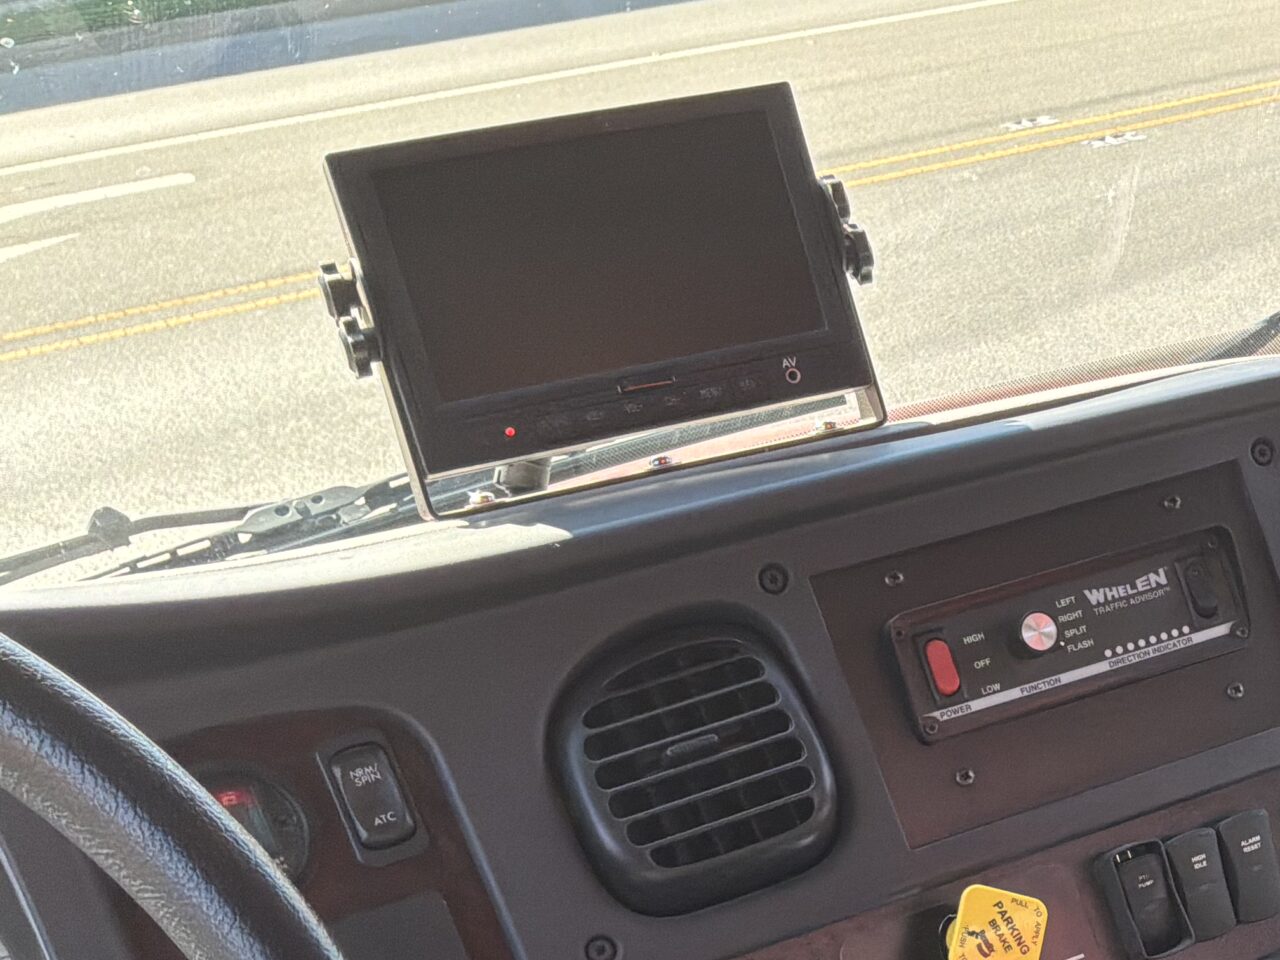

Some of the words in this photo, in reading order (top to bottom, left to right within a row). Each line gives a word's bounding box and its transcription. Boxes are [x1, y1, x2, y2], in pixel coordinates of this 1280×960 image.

[782, 356, 797, 368] AV
[1083, 567, 1168, 606] WHELEN
[1056, 596, 1076, 608] LEFT
[1093, 598, 1128, 617] TRAFFIC
[1058, 610, 1083, 623] RIGHT
[1064, 625, 1087, 638] SPLIT
[963, 632, 985, 646] HIGH
[1067, 638, 1094, 652] FLASH
[1108, 648, 1150, 668] DIRECTION
[1150, 636, 1193, 656] INDICATOR
[974, 658, 992, 669] OFF
[981, 682, 1001, 696] LOW
[1020, 677, 1061, 696] FUNCTION
[940, 703, 972, 720] POWER
[354, 771, 381, 787] SPIN
[374, 811, 397, 826] ATC
[1241, 835, 1260, 847] ALARM
[1243, 842, 1261, 853] RESET
[1192, 853, 1206, 863] HIGH
[1194, 860, 1207, 870] IDLE
[1138, 880, 1154, 888] PUMP
[1011, 897, 1029, 909] PULL
[1033, 906, 1042, 918] TO
[993, 900, 1030, 955] PARKING
[1032, 921, 1042, 946] APPLY
[957, 926, 969, 949] PUSH
[988, 919, 1013, 953] BRAKE
